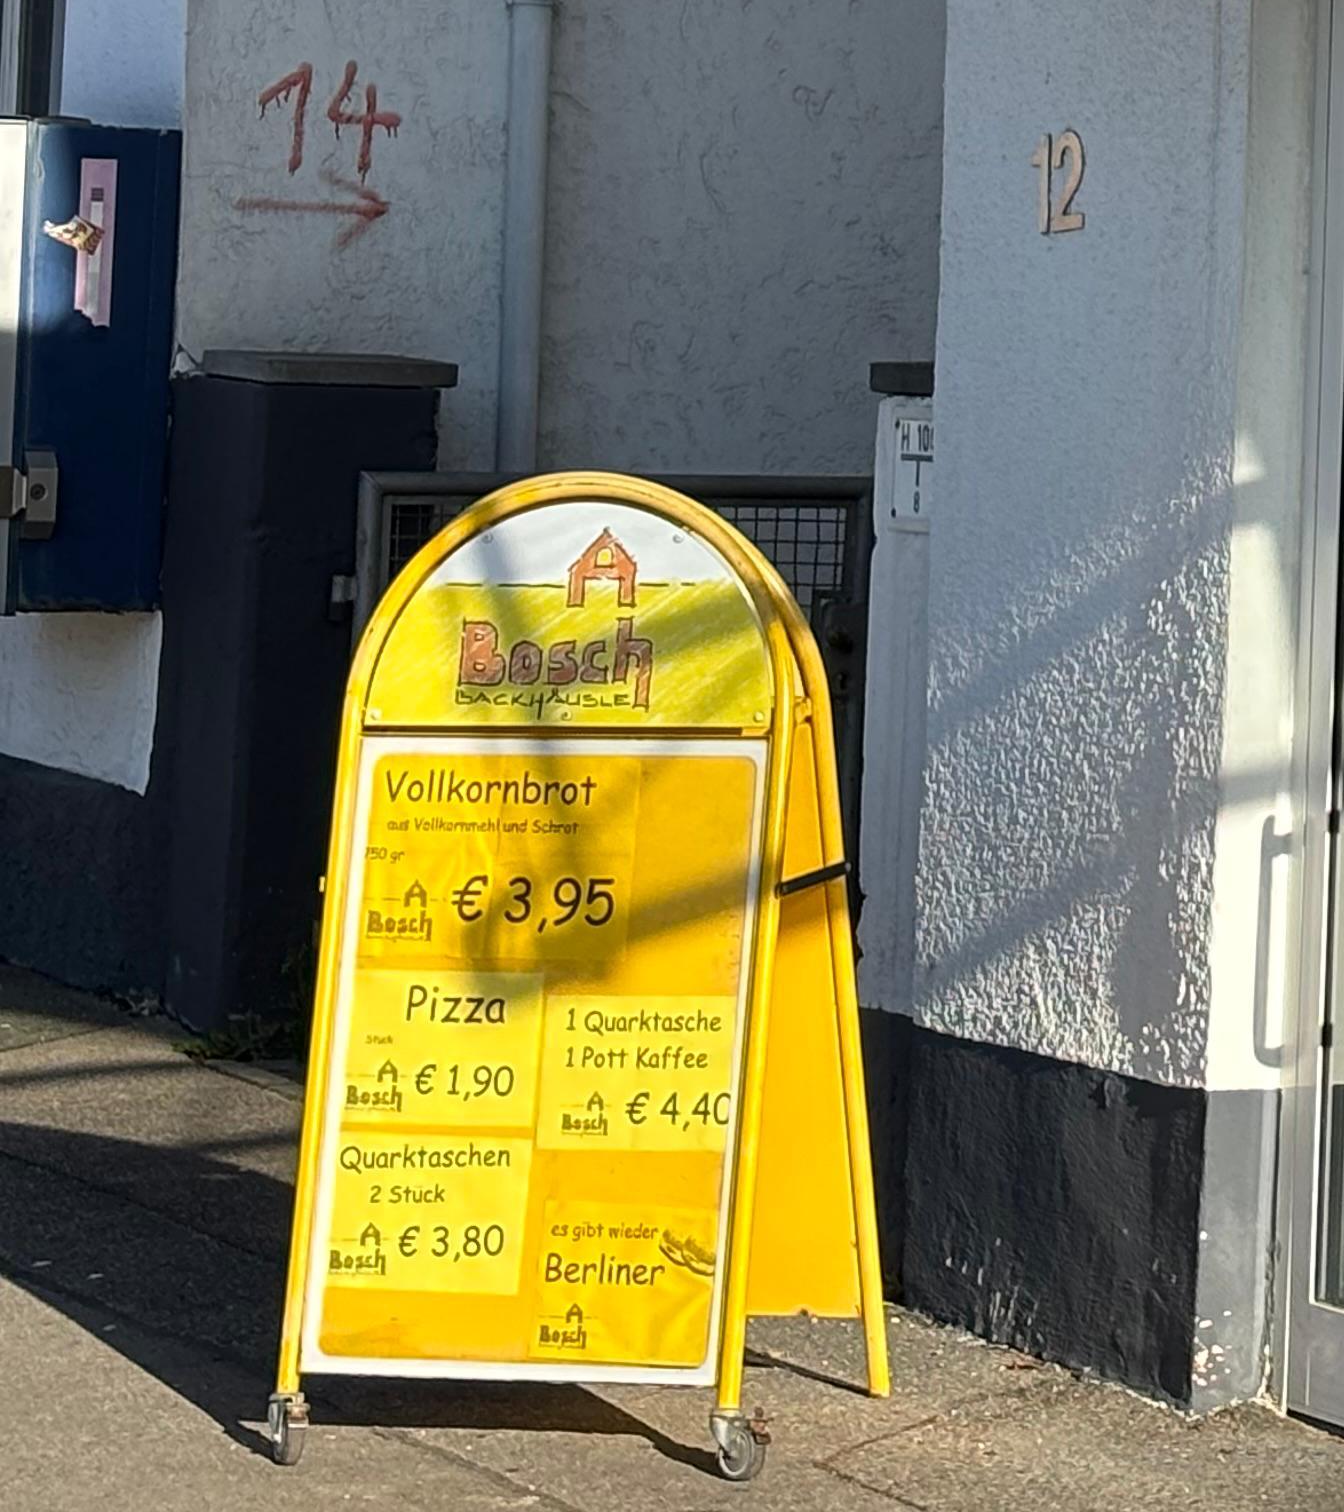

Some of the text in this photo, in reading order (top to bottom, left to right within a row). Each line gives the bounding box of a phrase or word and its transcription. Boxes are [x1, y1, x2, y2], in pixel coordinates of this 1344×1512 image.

[259, 59, 402, 182] 14
[1030, 126, 1087, 235] 12
[900, 422, 910, 452] H
[912, 490, 921, 514] 8
[457, 616, 653, 713] Bosch
[454, 688, 631, 720] BACKHÄUSLE
[386, 768, 598, 807] Vollkornbrot
[387, 817, 579, 836] aus Vollkornmehl und Schrot
[389, 850, 406, 865] gr
[451, 875, 615, 934] € 3,95
[366, 910, 433, 942] Bosch
[406, 984, 506, 1024] Pizza
[565, 1007, 722, 1037] 1 Quarktasche
[565, 1045, 708, 1070] 1 Pott Kaffee
[346, 1084, 403, 1113] Bosch
[415, 1063, 515, 1102] € 1,90
[560, 1113, 609, 1137] Bosch
[625, 1091, 732, 1133] € 4,40
[340, 1142, 511, 1175] Quarktaschen
[369, 1185, 382, 1204] 2
[398, 1224, 505, 1263] € 3,80
[551, 1221, 659, 1242] es gibt wieder
[328, 1248, 387, 1276] Bosch
[545, 1252, 666, 1286] Berliner
[539, 1324, 587, 1350] Bosch
